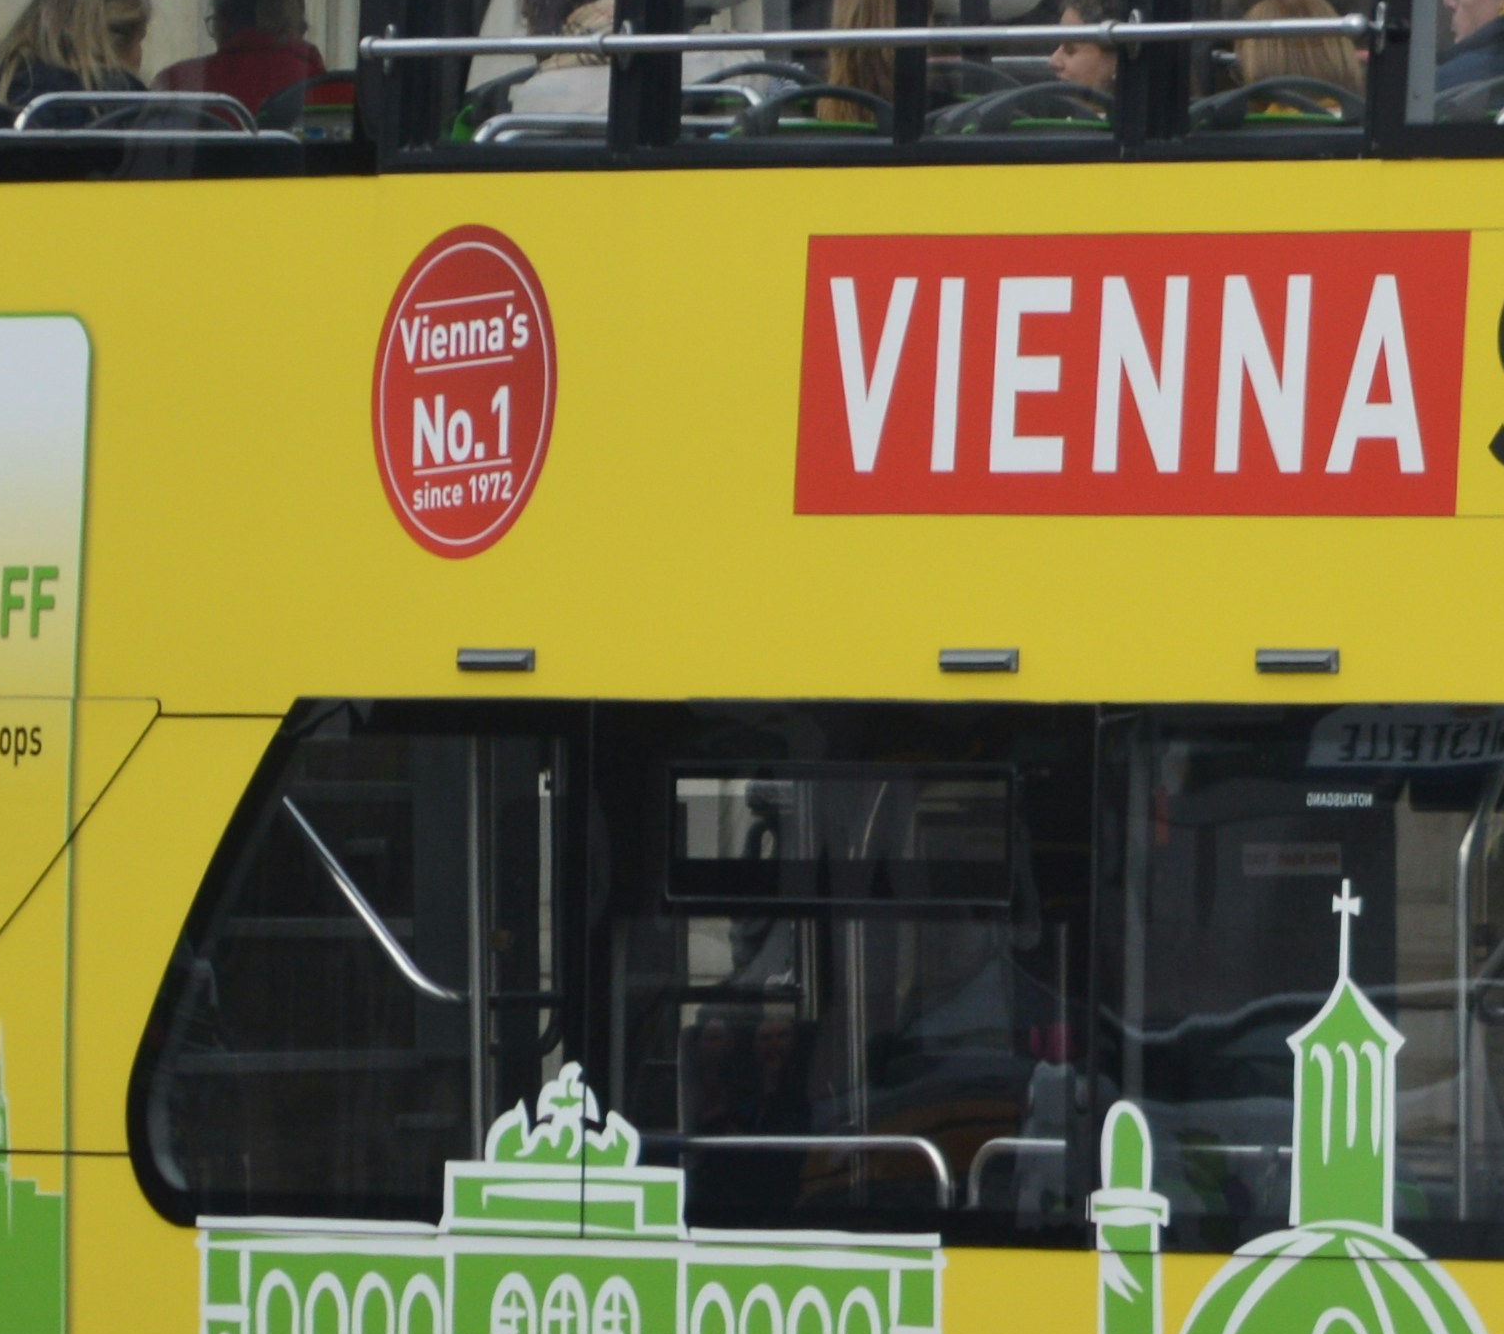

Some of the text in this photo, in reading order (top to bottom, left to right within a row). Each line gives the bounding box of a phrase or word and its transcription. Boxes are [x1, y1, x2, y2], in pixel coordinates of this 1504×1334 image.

[399, 304, 530, 365] Vienna's
[829, 273, 1426, 473] VIENNA
[413, 470, 513, 512] since 1972
